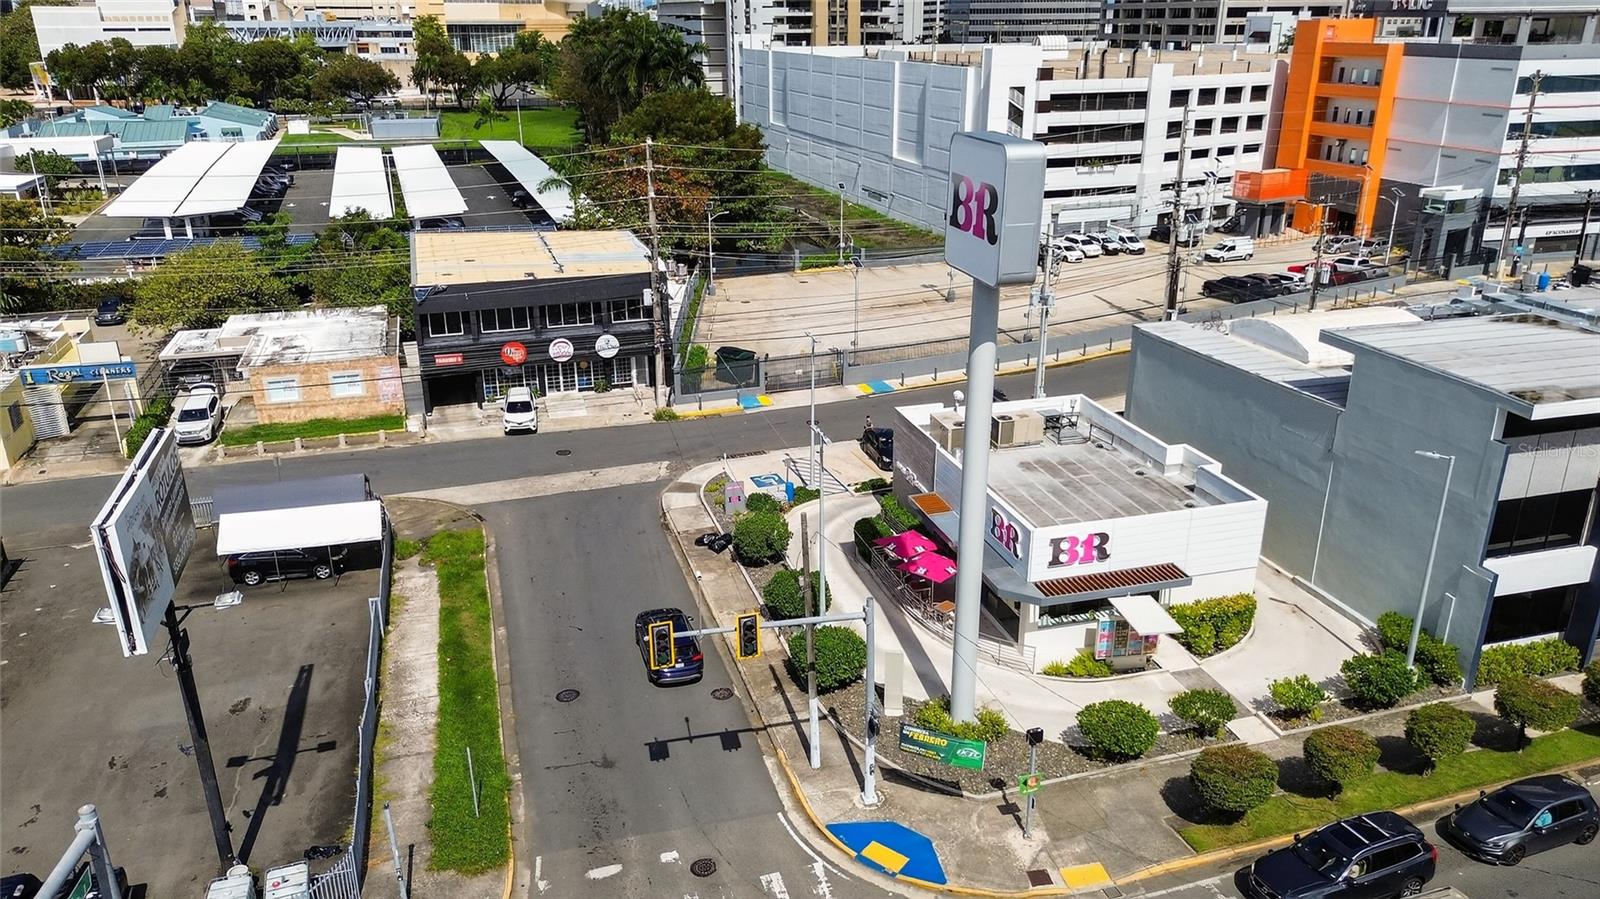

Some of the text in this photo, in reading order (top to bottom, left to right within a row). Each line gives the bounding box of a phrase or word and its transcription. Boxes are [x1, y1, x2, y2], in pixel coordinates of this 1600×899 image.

[949, 172, 999, 246] BR
[990, 506, 1021, 560] BR
[1046, 532, 1111, 569] BR
